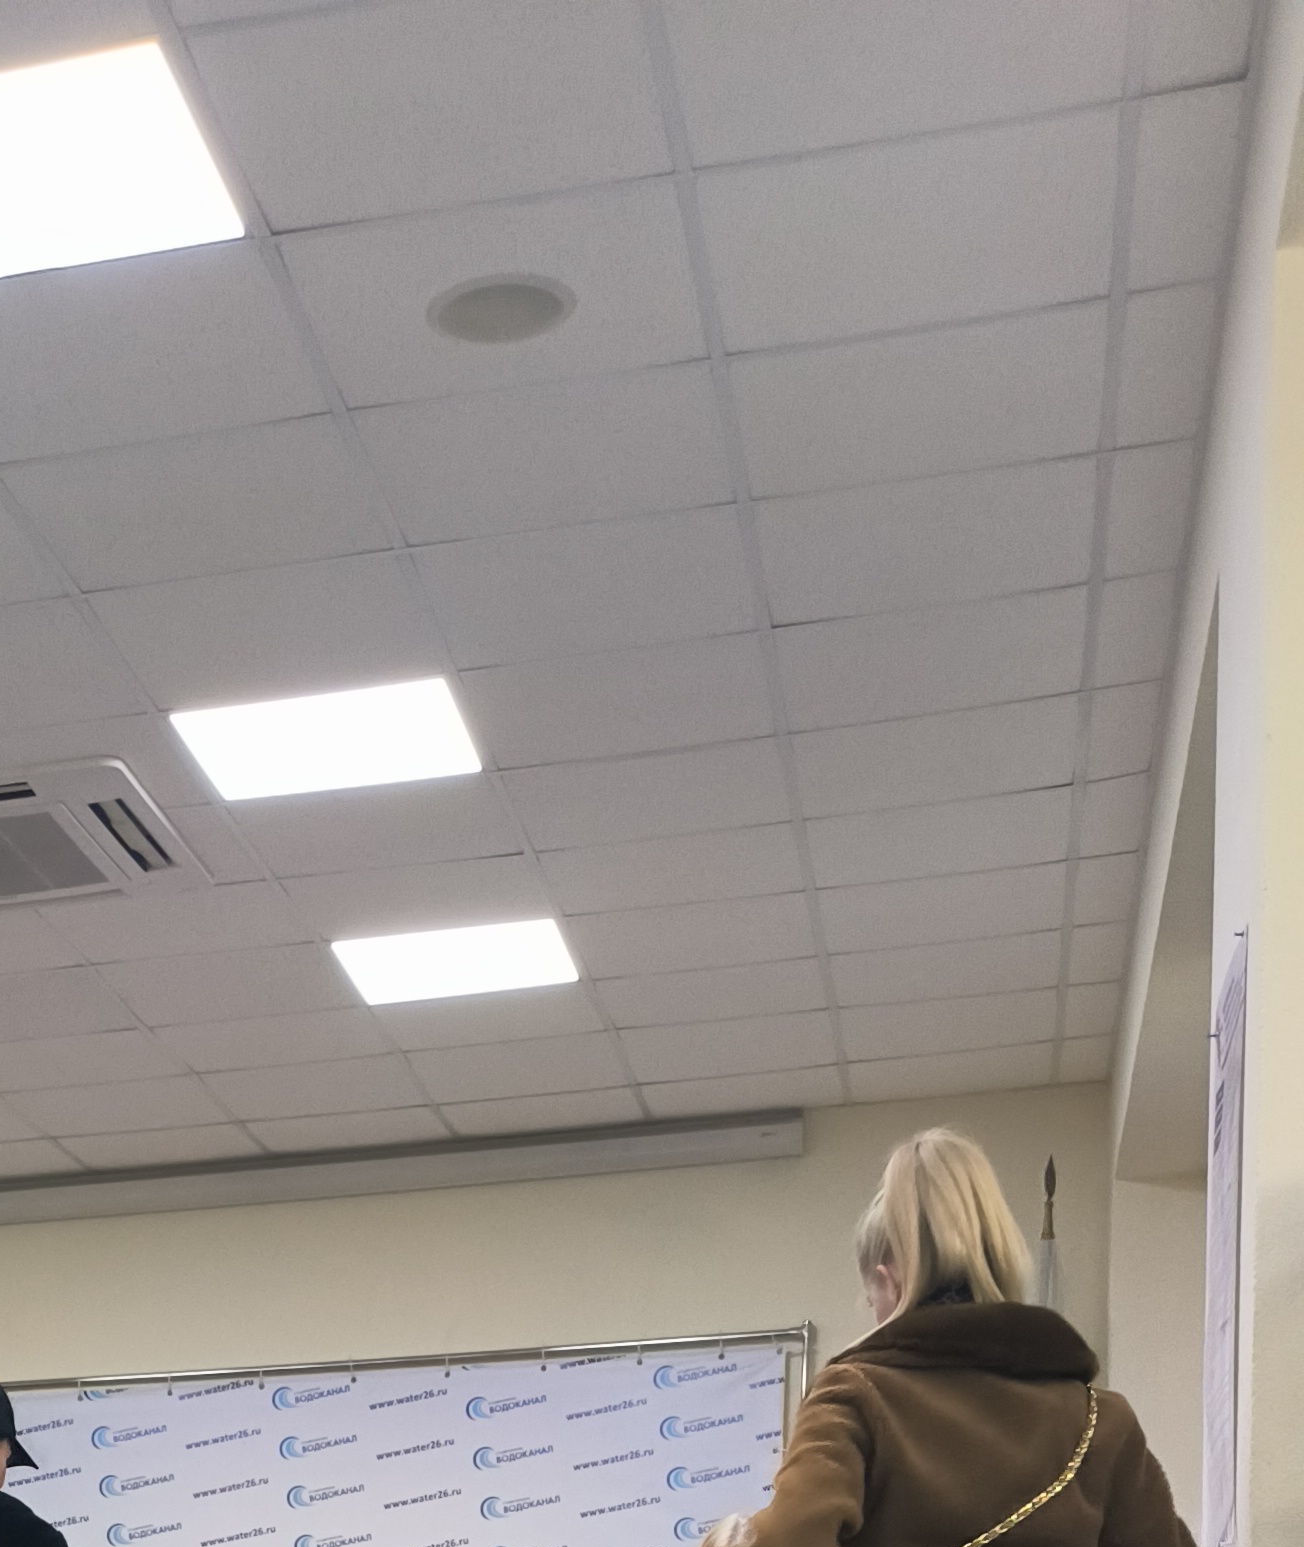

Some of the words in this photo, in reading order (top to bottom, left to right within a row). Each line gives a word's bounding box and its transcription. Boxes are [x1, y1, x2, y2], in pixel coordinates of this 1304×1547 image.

[677, 1363, 737, 1383] ВОДОКАНАЛ
[178, 1380, 254, 1401] www.water26.ru
[295, 1385, 350, 1404] ВОДОКАНАЛ
[369, 1388, 447, 1410] www.water26.ru
[489, 1395, 547, 1414] ВОДОКАНАЛ
[566, 1398, 647, 1420] www.water26.ru
[16, 1419, 74, 1436] w.water26.ru
[113, 1425, 167, 1442] ВОДОКАНАЛ
[684, 1414, 743, 1434] ВОДОКАНАЛ
[185, 1428, 261, 1450] www.water26.ru
[302, 1435, 357, 1454] ВОДОКАНАЛ
[376, 1439, 454, 1460] www.water26.ru
[496, 1445, 553, 1464] ВОДОКАНАЛ
[573, 1449, 654, 1471] www.water26.ru
[8, 1467, 81, 1488] www.water26.ru
[121, 1474, 174, 1492] ВОДОКАНАЛ
[691, 1465, 750, 1485] ВОДОКАНАЛ
[193, 1478, 269, 1499] www.water26.ru
[309, 1484, 364, 1503] ВОДОКАНАЛ
[383, 1488, 461, 1509] www.water26.ru
[503, 1495, 560, 1514] ВОДОКАНАЛ
[580, 1496, 661, 1518] www.water26.ru
[128, 1522, 182, 1540] ВОДОКАНАЛ
[200, 1527, 276, 1547] www.water26.ru
